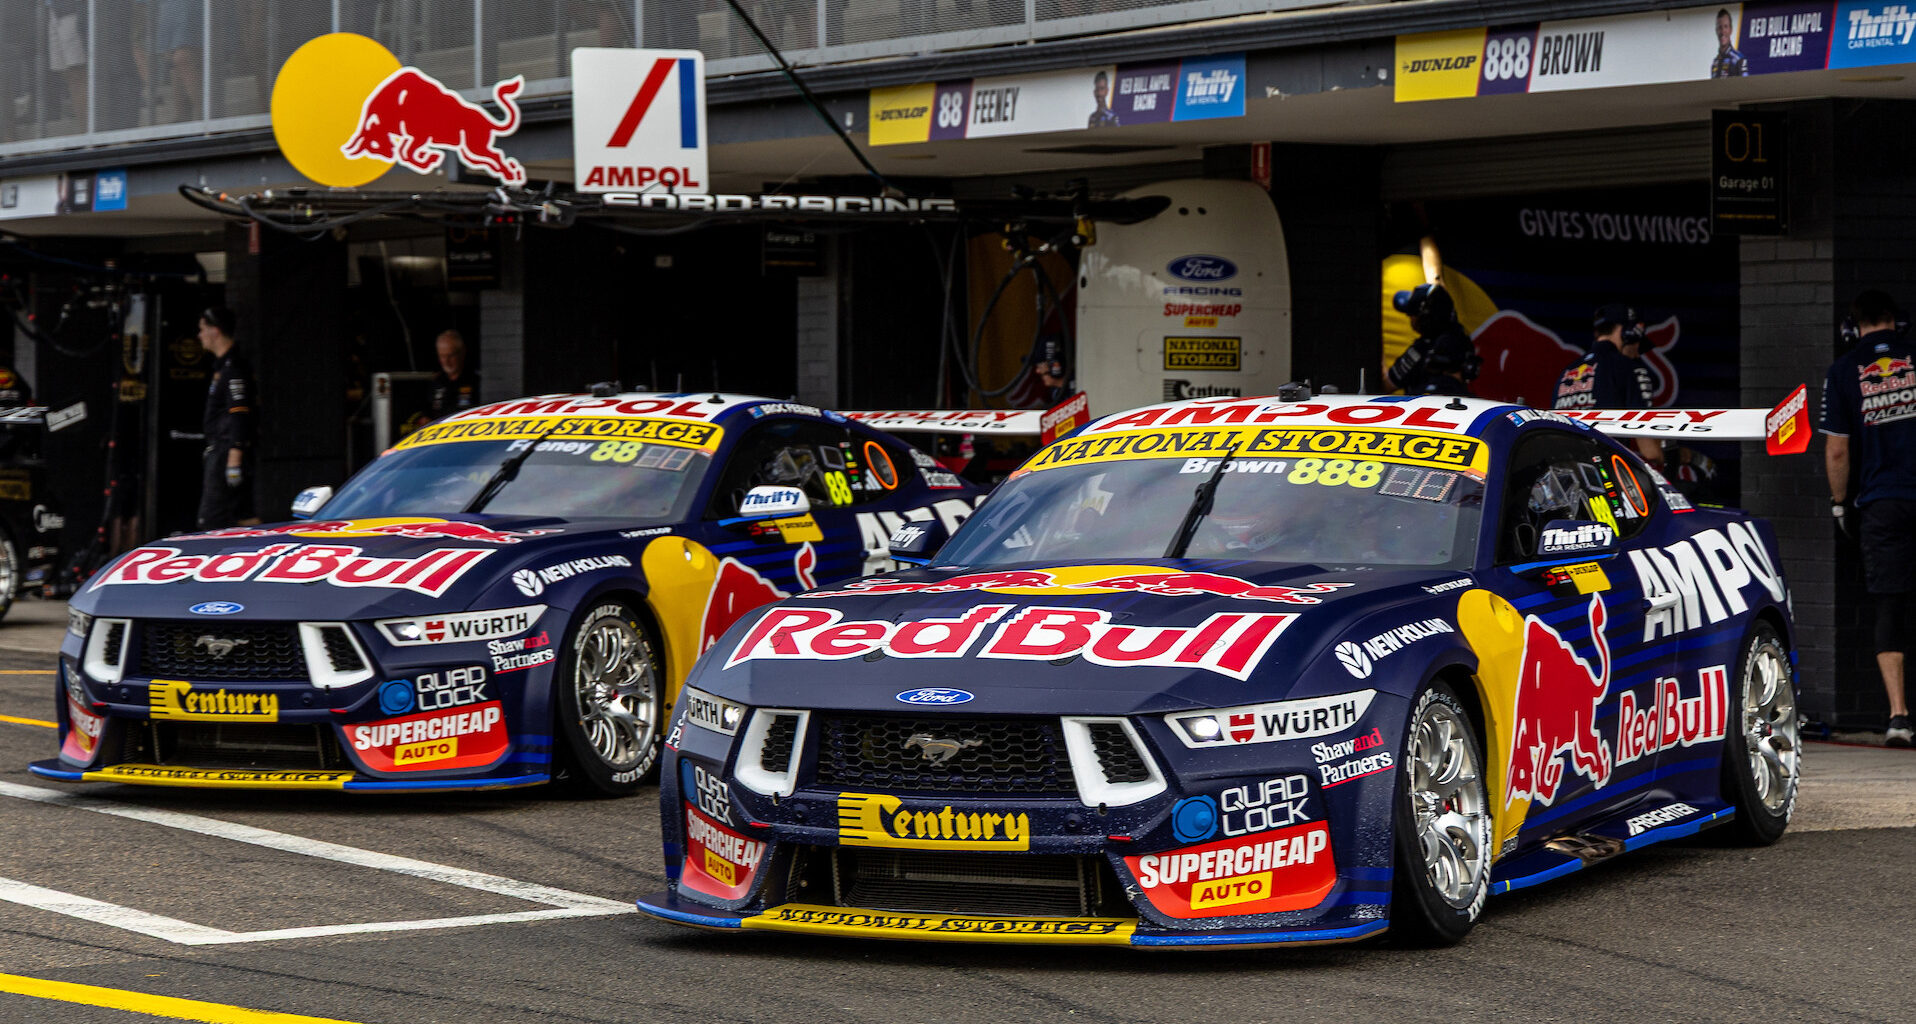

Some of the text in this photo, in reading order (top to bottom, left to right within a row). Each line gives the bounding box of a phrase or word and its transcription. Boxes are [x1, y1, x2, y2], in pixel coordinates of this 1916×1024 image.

[1749, 12, 1823, 38] RED BULL AMPOL
[1848, 6, 1916, 44] Thrifty
[1538, 32, 1605, 76] BROWN
[1768, 36, 1803, 58] RACING
[1848, 37, 1893, 50] CAR RENTAL
[1408, 55, 1477, 73] DUNLOP
[1483, 36, 1531, 81] 888
[1185, 69, 1237, 103] Thrifty
[880, 106, 928, 121] DUNLOP
[937, 91, 963, 129] 88
[972, 86, 1021, 125] FEENEY
[1725, 121, 1769, 163] 01
[583, 166, 699, 187] AMPOL
[1719, 175, 1776, 193] Garage 01
[1519, 208, 1711, 244] GIVES YOU WINGS
[1180, 258, 1224, 278] Ford
[1163, 286, 1242, 297] RACING
[1163, 303, 1242, 317] SUPERCHEAP
[1187, 317, 1216, 327] AUTO
[1168, 340, 1237, 351] NATIONAL
[1170, 353, 1234, 365] STORAGE
[1167, 379, 1241, 400] Century
[453, 398, 713, 420] AMPOL
[840, 410, 1027, 422] MPLIFY
[1091, 403, 1463, 431] AMPOL
[402, 419, 713, 446] NATIONAL STORAGE
[590, 440, 643, 463] 88
[1036, 429, 1472, 467] NATIONAL STORAGE
[1179, 457, 1385, 489] Brown 888
[745, 490, 801, 505] Thrifty
[824, 470, 852, 506] 88
[1542, 524, 1613, 546] Thrifty
[1543, 541, 1597, 552] CAR RENTAL
[537, 555, 632, 586] NEW HOLLAND
[1626, 520, 1786, 643] AMPOL
[449, 612, 528, 639] WÜRTH
[1361, 617, 1455, 662] NEW HOLLAND
[487, 630, 550, 657] Shaw and
[491, 647, 555, 674] Partners
[416, 665, 487, 693] QUAD
[160, 679, 278, 718] Century
[416, 683, 489, 711] LOCK
[687, 693, 719, 726] ÜRTH
[353, 706, 500, 751] SUPERCHEAP
[1260, 701, 1357, 738] WÜRTH
[400, 743, 450, 761] AUTO
[1310, 728, 1385, 764] Shaw and
[1317, 751, 1394, 787] Partners
[694, 765, 730, 804] QUAD
[1220, 773, 1309, 812] QUAD
[697, 789, 735, 827] LOCK
[852, 792, 1030, 844] Century
[1221, 797, 1310, 837] LOCK
[707, 857, 732, 881] AUTO
[1138, 828, 1328, 889] SUPERCHEAP
[1198, 878, 1263, 904] AUTO
